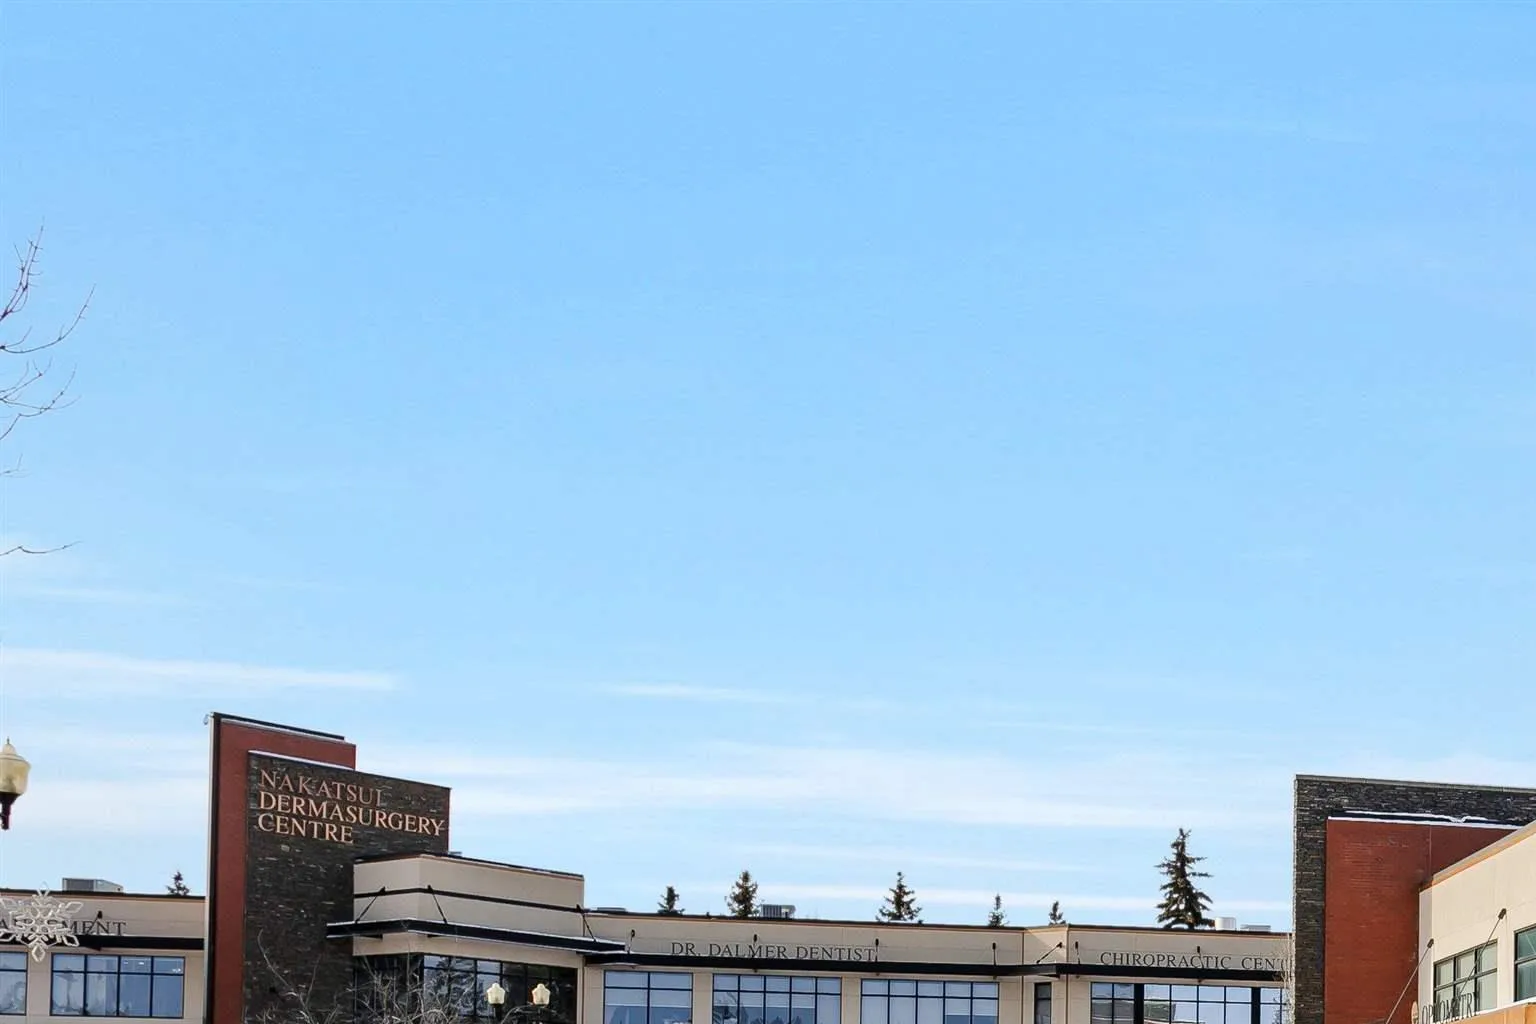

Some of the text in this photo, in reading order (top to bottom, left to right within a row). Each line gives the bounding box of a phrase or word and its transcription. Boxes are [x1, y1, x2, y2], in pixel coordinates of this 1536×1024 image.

[259, 769, 383, 807] NAKATSUI
[257, 813, 354, 844] CENTRE
[259, 791, 446, 836] DERMASURGERY
[671, 942, 876, 962] DR. DALMER DENTIST
[1100, 951, 1232, 970] CHIROPRACTIC
